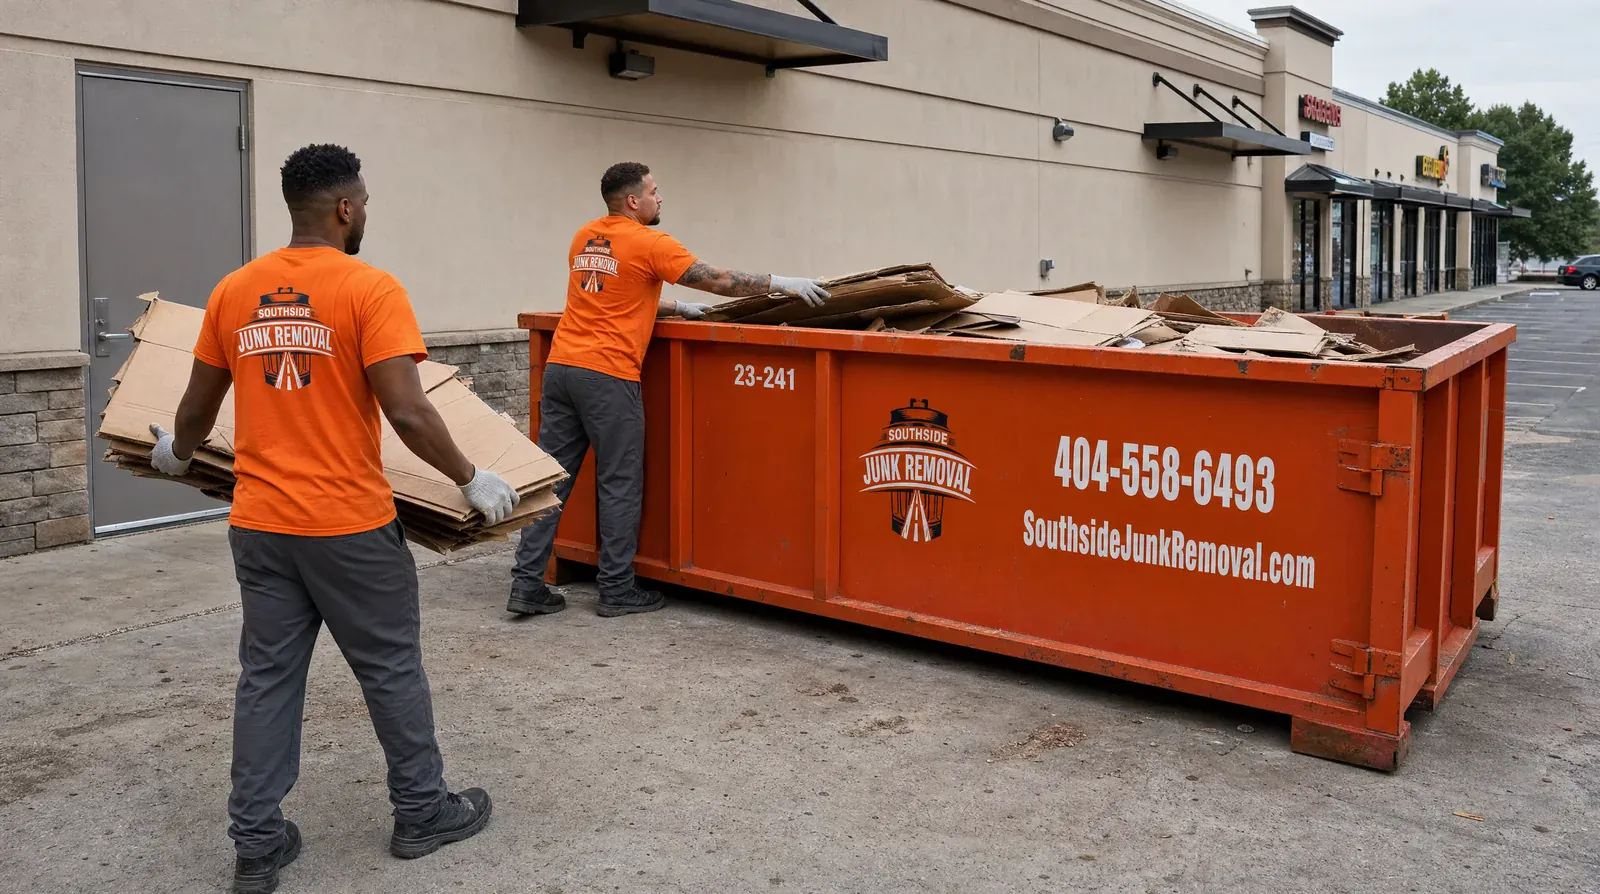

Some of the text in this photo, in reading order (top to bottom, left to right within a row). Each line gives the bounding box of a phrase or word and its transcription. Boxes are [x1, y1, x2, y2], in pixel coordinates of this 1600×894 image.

[572, 256, 618, 274] JUNK REMOVAL
[258, 307, 311, 318] SOUTHSIDE
[238, 326, 333, 352] JUNK REMOVAL
[734, 363, 795, 391] 23-241
[888, 427, 948, 445] SOUTHSIDE
[863, 453, 972, 495] JUNK REMOVAL
[1054, 435, 1275, 513] 404-558-6493
[1023, 509, 1315, 589] SouthsideJunkRemoval.com
